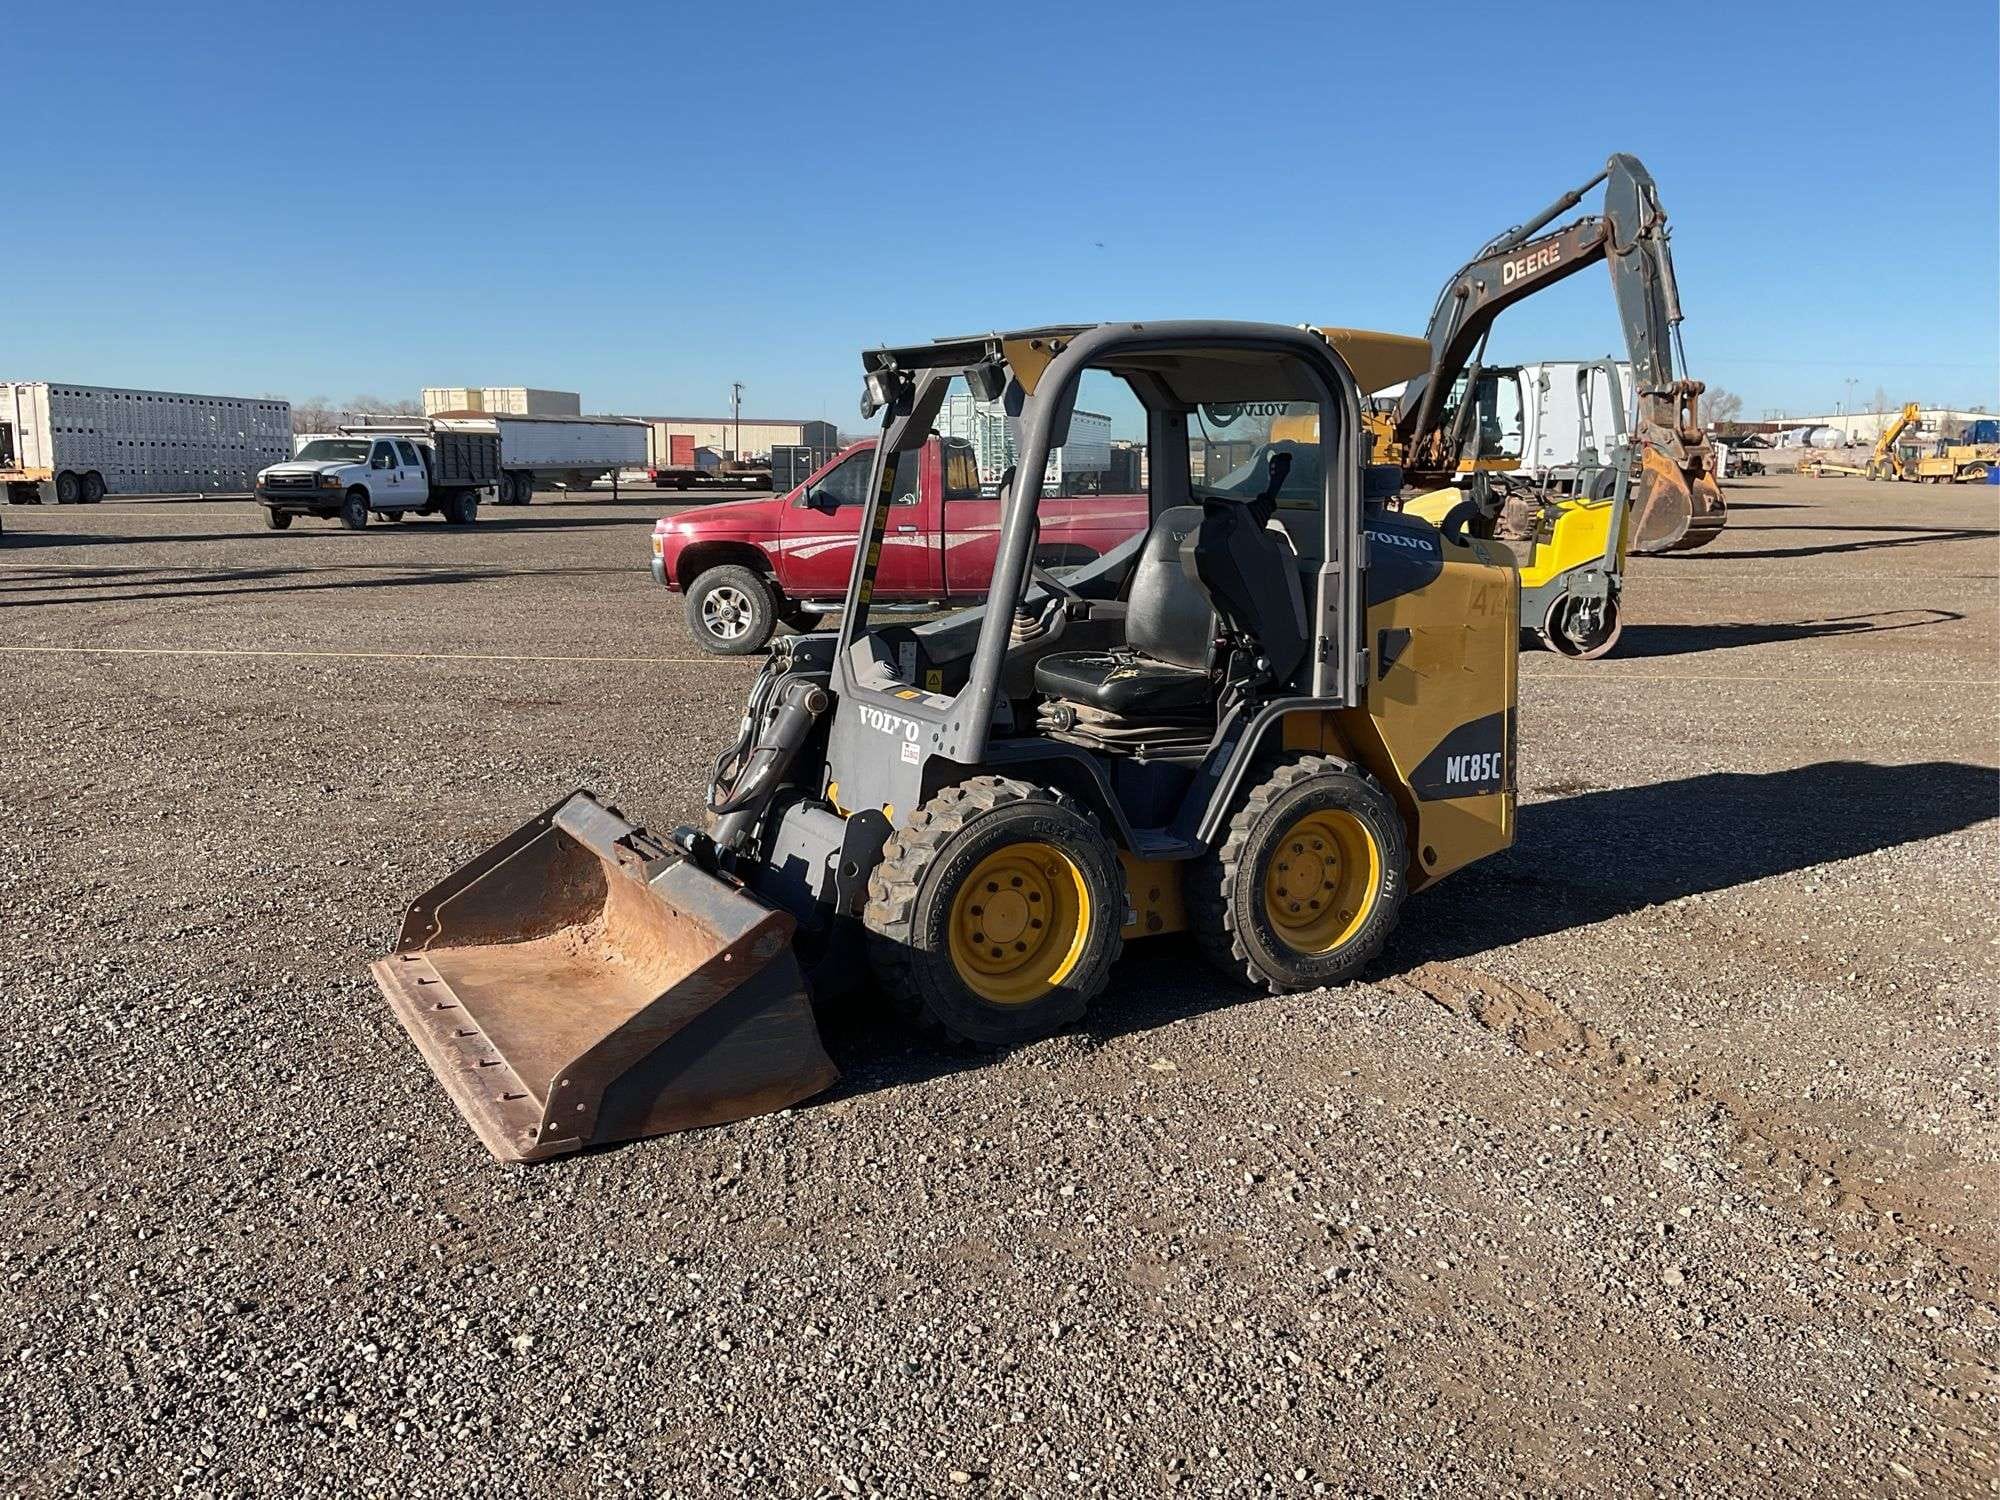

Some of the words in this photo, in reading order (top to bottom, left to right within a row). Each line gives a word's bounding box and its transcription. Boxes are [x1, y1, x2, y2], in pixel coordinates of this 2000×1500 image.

[1503, 242, 1561, 285] DEERE
[859, 704, 920, 741] VOLVO
[1446, 752, 1502, 784] MC85C
